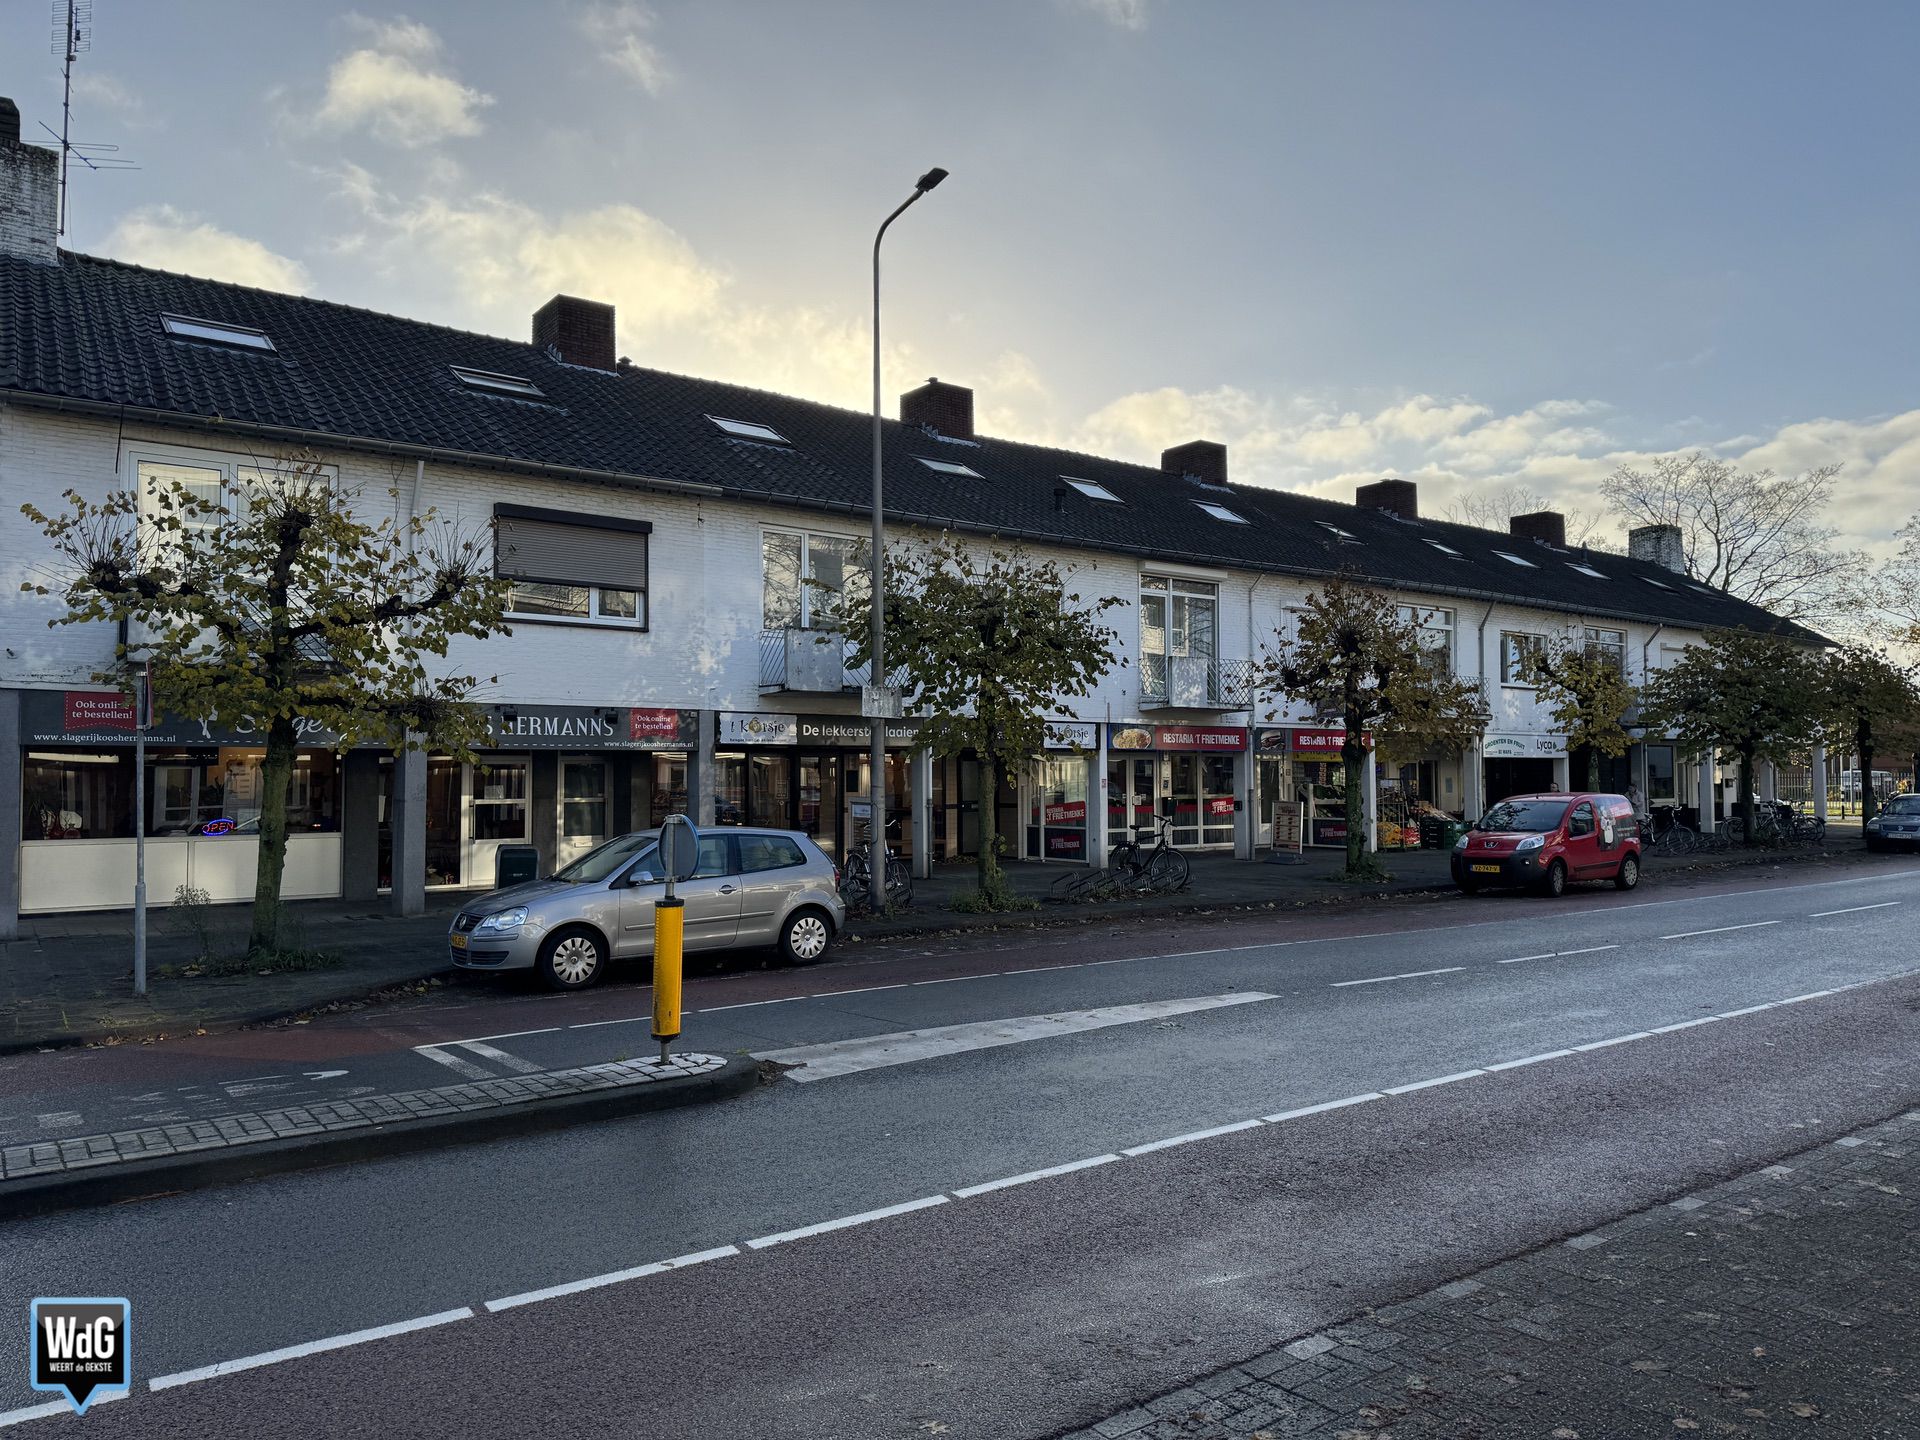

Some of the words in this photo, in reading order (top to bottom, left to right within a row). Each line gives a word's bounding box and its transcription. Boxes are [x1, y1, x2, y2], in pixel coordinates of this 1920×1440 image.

[76, 700, 96, 709] Ook
[84, 710, 133, 718] bestellen!
[643, 722, 673, 730] bestellen!
[803, 724, 819, 737] De
[822, 725, 872, 738] lekkerst
[1163, 733, 1194, 744] RESTARIA
[1201, 734, 1240, 745] FRIETMENKE
[1299, 736, 1326, 746] RESTARIA
[604, 740, 694, 749] www.slagerijkooshermanns.nl
[1536, 739, 1553, 751] Lyca
[202, 822, 235, 833] OPEN
